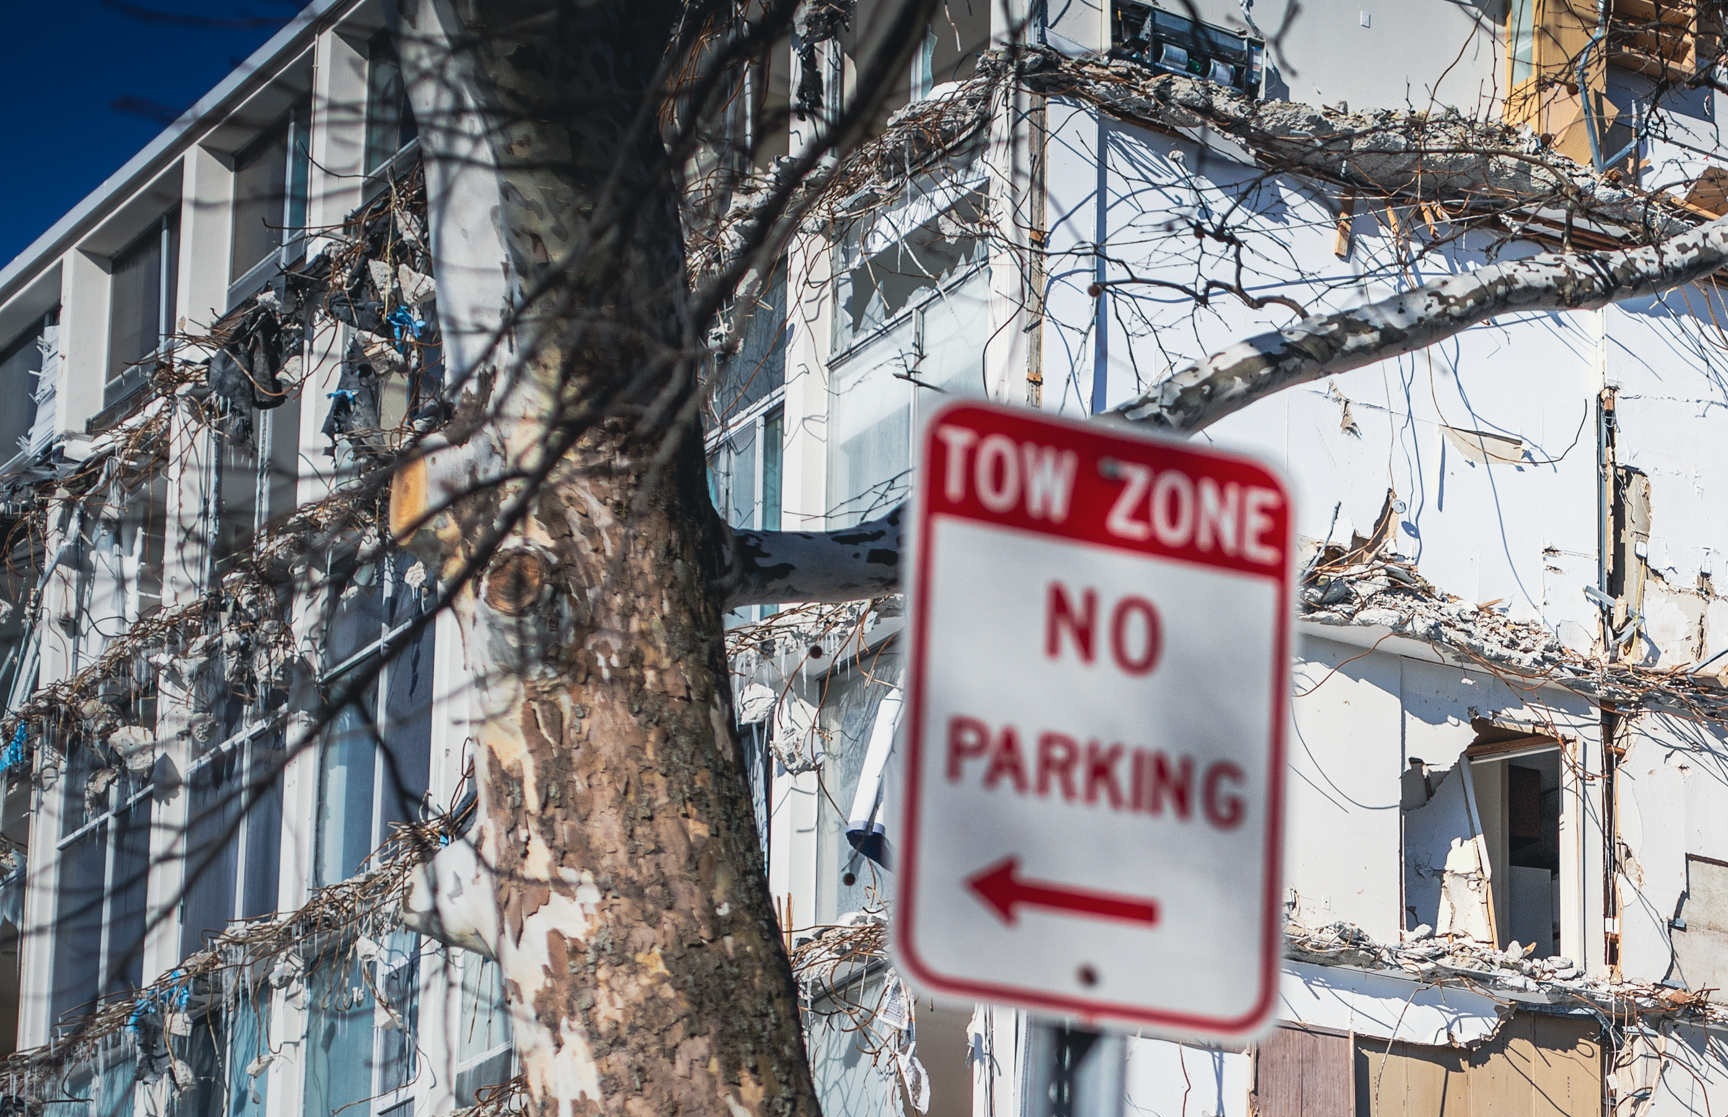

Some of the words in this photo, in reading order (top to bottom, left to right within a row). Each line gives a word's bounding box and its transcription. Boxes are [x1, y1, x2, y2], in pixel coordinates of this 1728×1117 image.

[938, 427, 1077, 522] TOW
[1106, 463, 1280, 566] ZONE
[1045, 579, 1163, 677] NO
[944, 715, 1246, 831] PARKING
